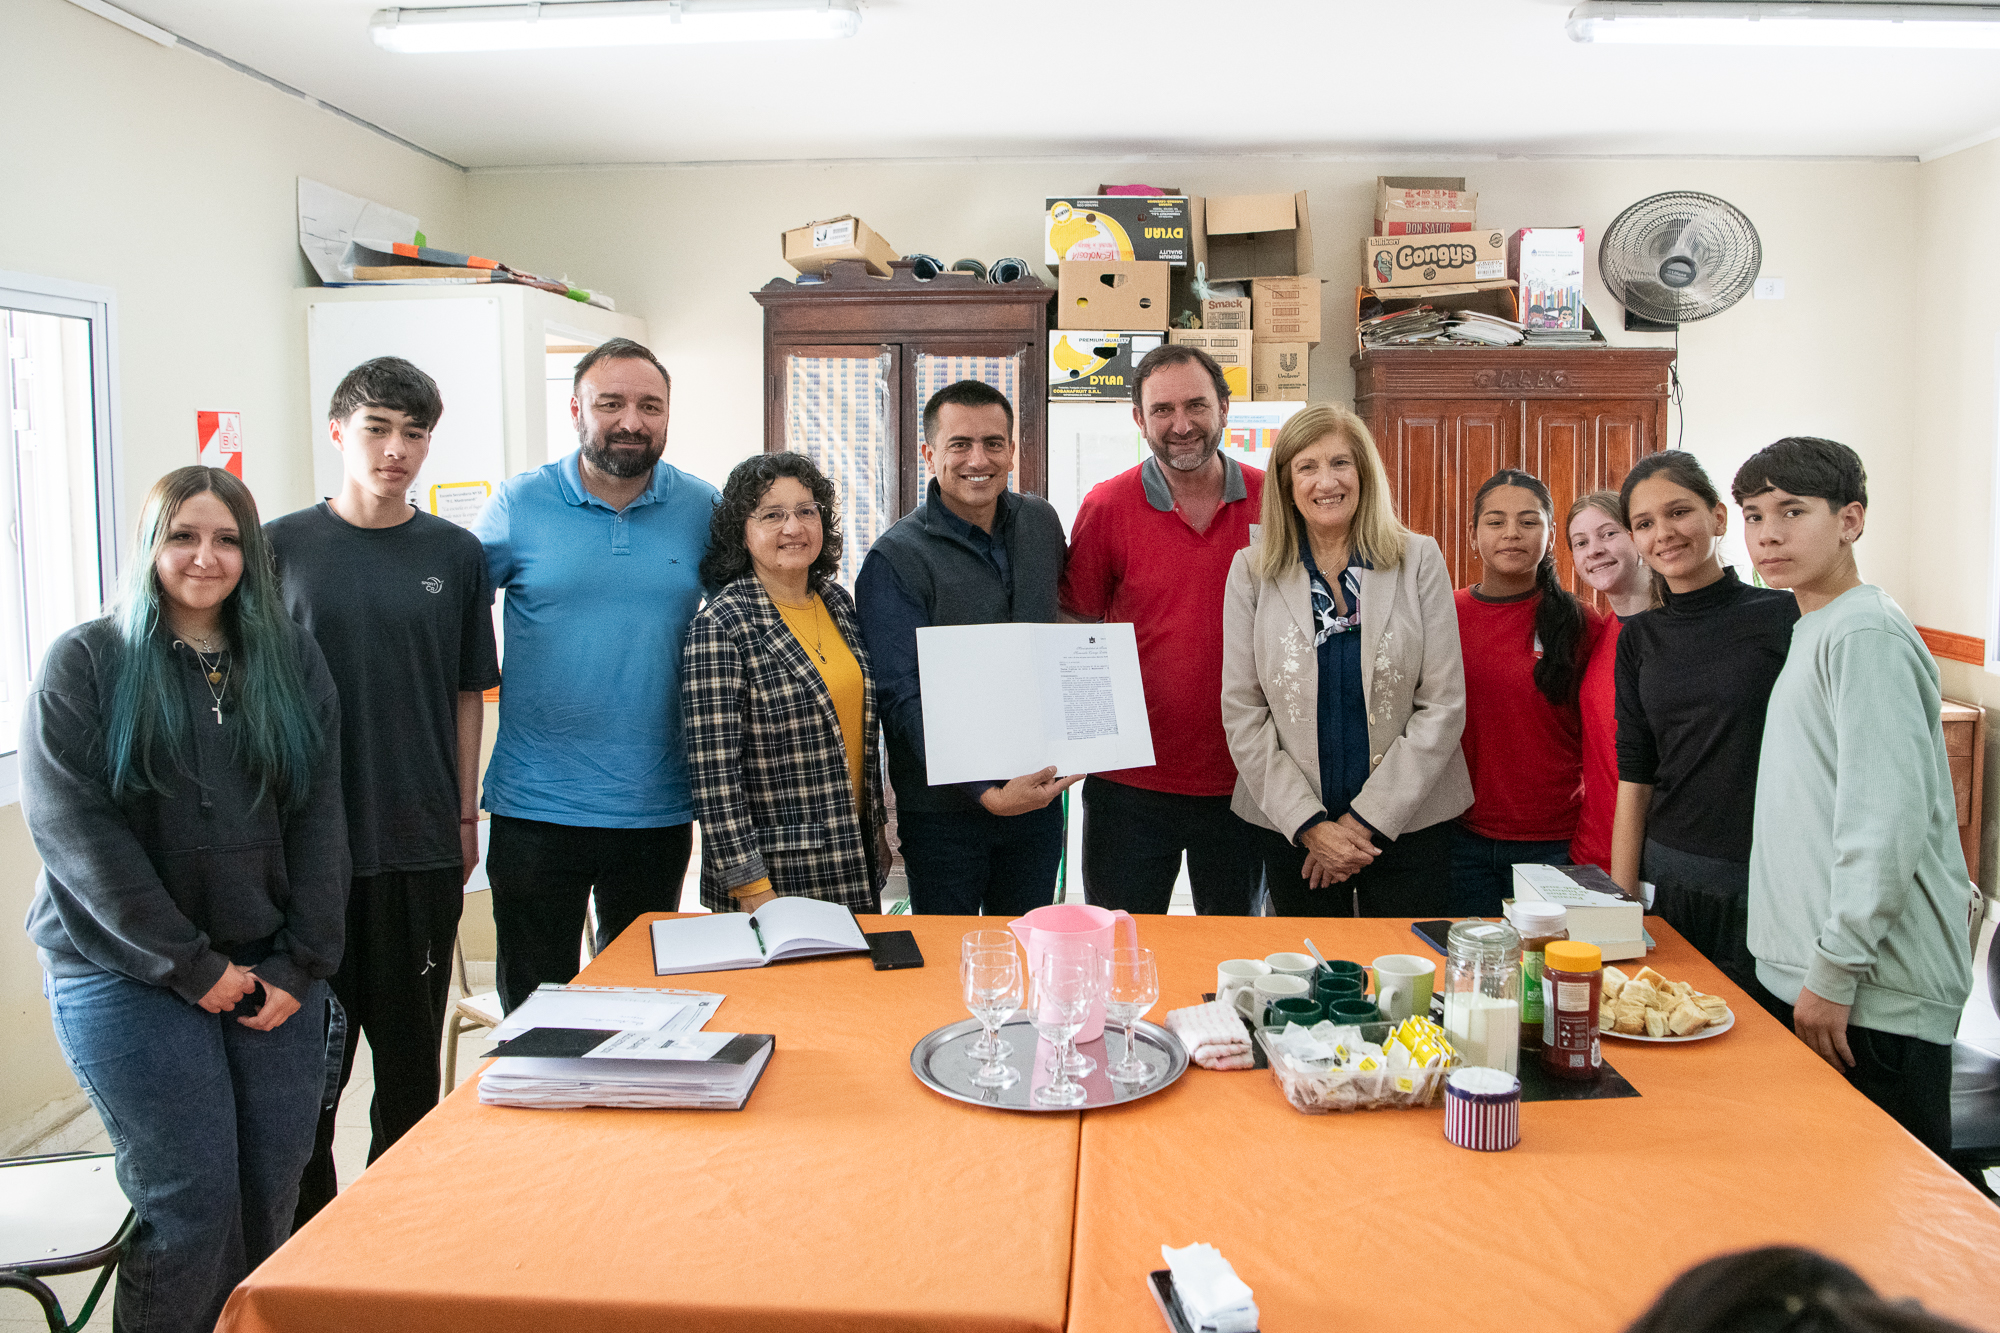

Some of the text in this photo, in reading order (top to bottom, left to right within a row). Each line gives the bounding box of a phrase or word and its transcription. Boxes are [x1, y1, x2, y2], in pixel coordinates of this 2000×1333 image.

[1144, 228, 1184, 238] DYLAN
[1406, 222, 1452, 234] DON SATUR
[1396, 244, 1476, 270] Gongys
[1208, 300, 1242, 310] Smack
[1090, 376, 1124, 386] DYLAN
